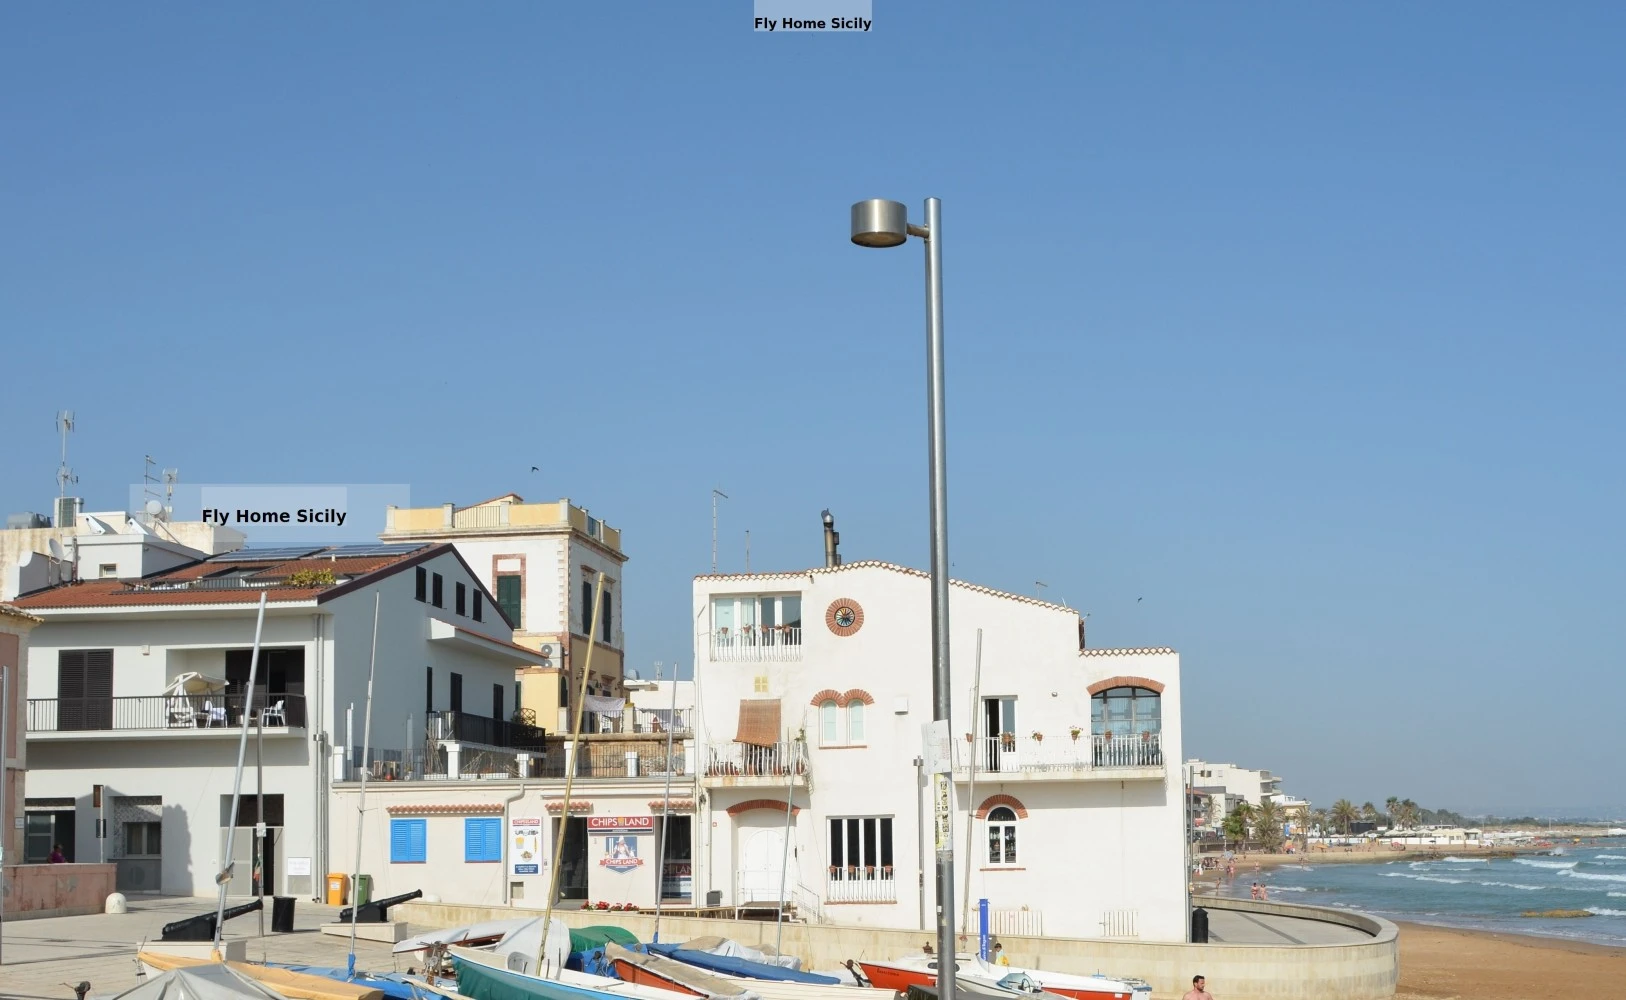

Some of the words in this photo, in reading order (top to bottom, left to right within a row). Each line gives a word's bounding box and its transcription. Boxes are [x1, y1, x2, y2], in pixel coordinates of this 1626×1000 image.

[591, 817, 618, 827] CHIPS
[624, 817, 649, 826] LAND
[675, 865, 691, 874] LAN
